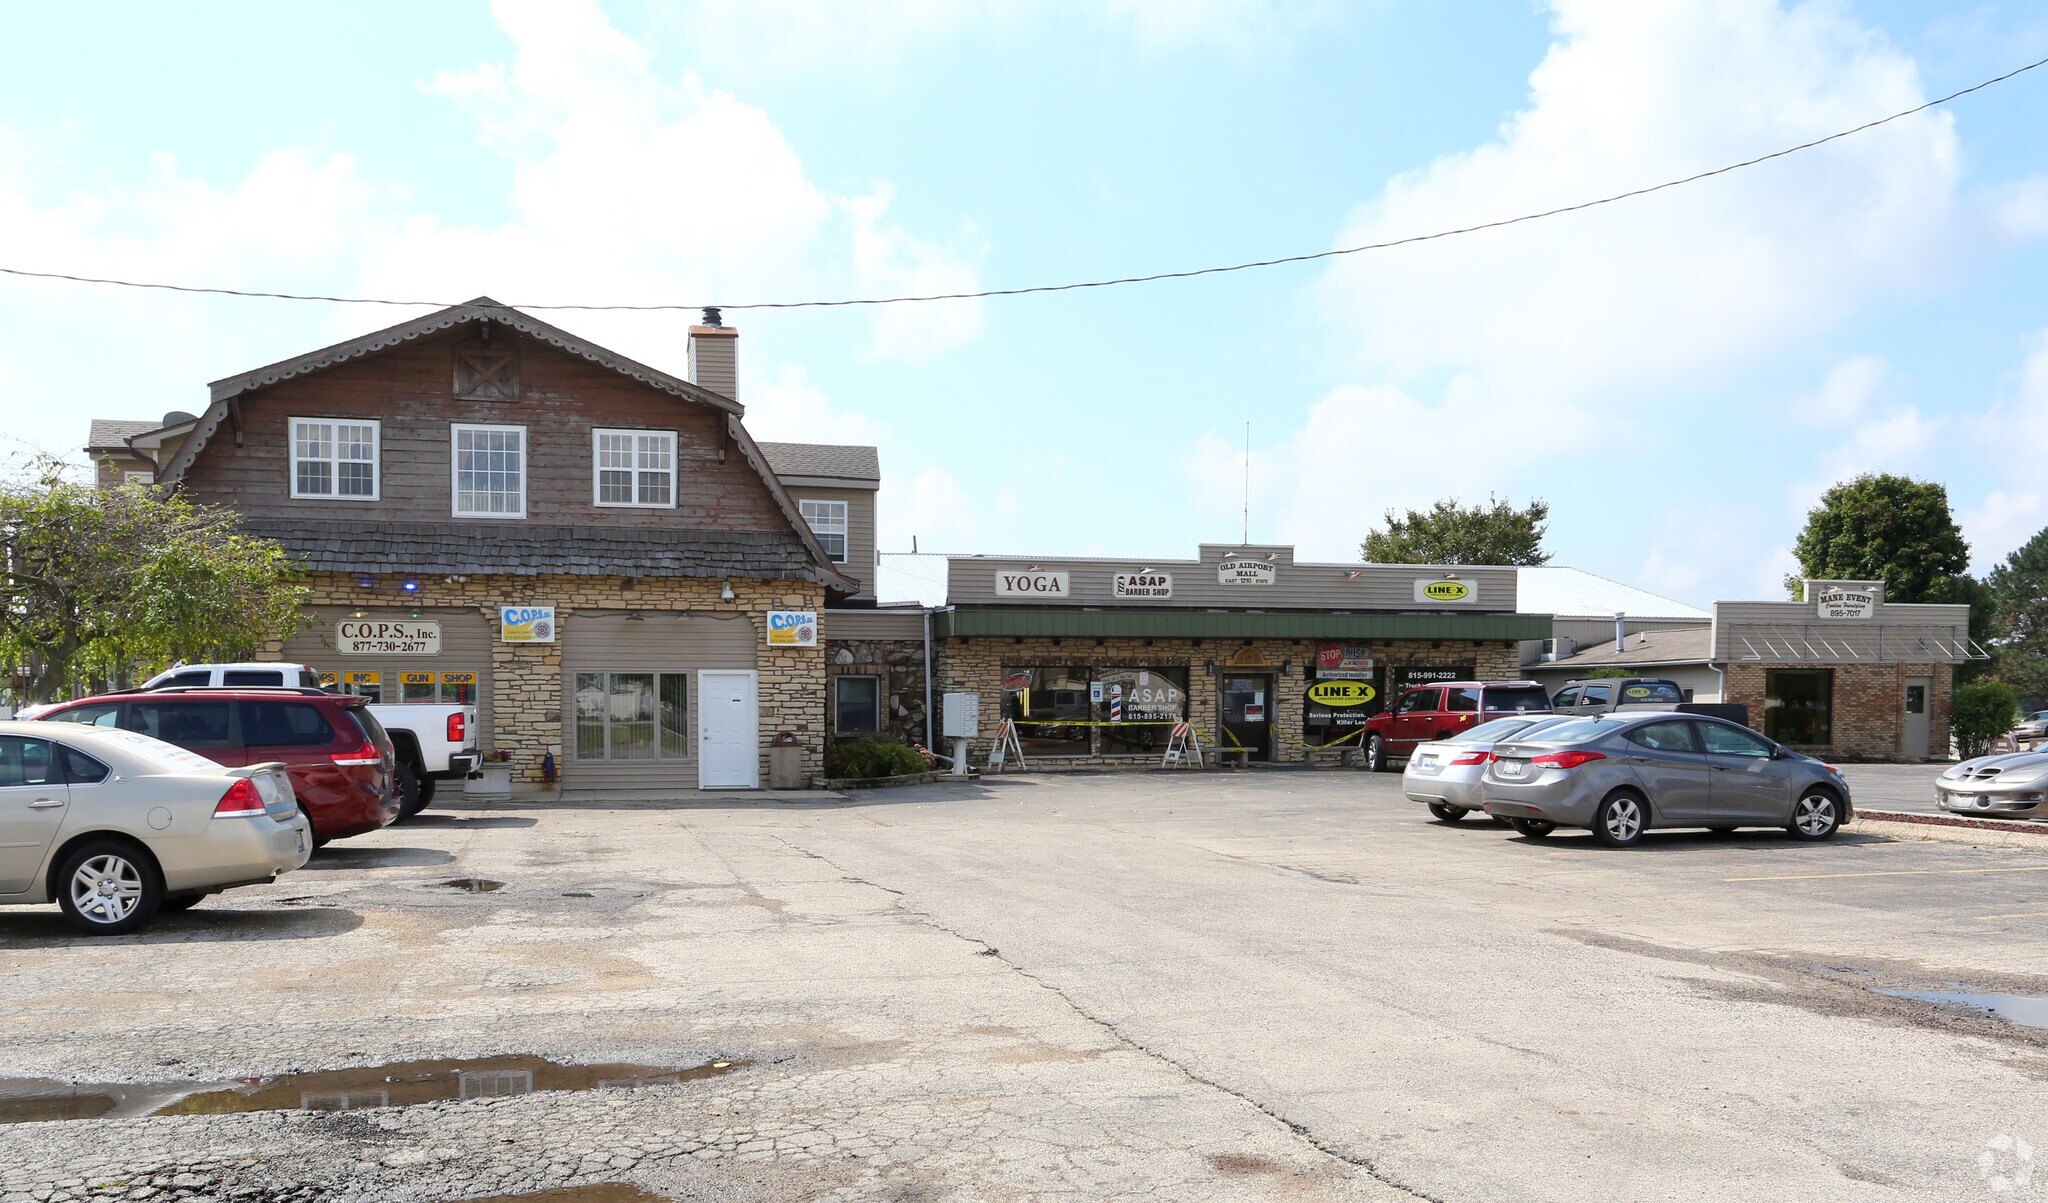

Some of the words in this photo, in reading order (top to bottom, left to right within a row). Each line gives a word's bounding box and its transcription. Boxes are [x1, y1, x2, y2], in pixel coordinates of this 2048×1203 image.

[1220, 563, 1236, 571] OLD
[1238, 562, 1274, 572] AIRPORT
[1003, 575, 1061, 592] YOGA
[1128, 576, 1167, 586] ASAP
[1125, 588, 1150, 596] BARBER
[1152, 588, 1170, 596] SHOP
[1820, 594, 1844, 604] MANE
[1845, 594, 1872, 604] EVENT
[1830, 609, 1861, 617] 895-7017
[341, 623, 414, 641] C.O.P.S.,
[417, 628, 437, 639] Inc.
[352, 641, 427, 652] 877-730-2677
[1320, 649, 1341, 661] STOP
[316, 673, 336, 682] OPS
[353, 673, 371, 682] INC
[406, 673, 429, 683] GUN
[444, 673, 473, 683] SHOP
[1408, 671, 1456, 679] 815-991-2222
[1128, 688, 1178, 703] ASAP
